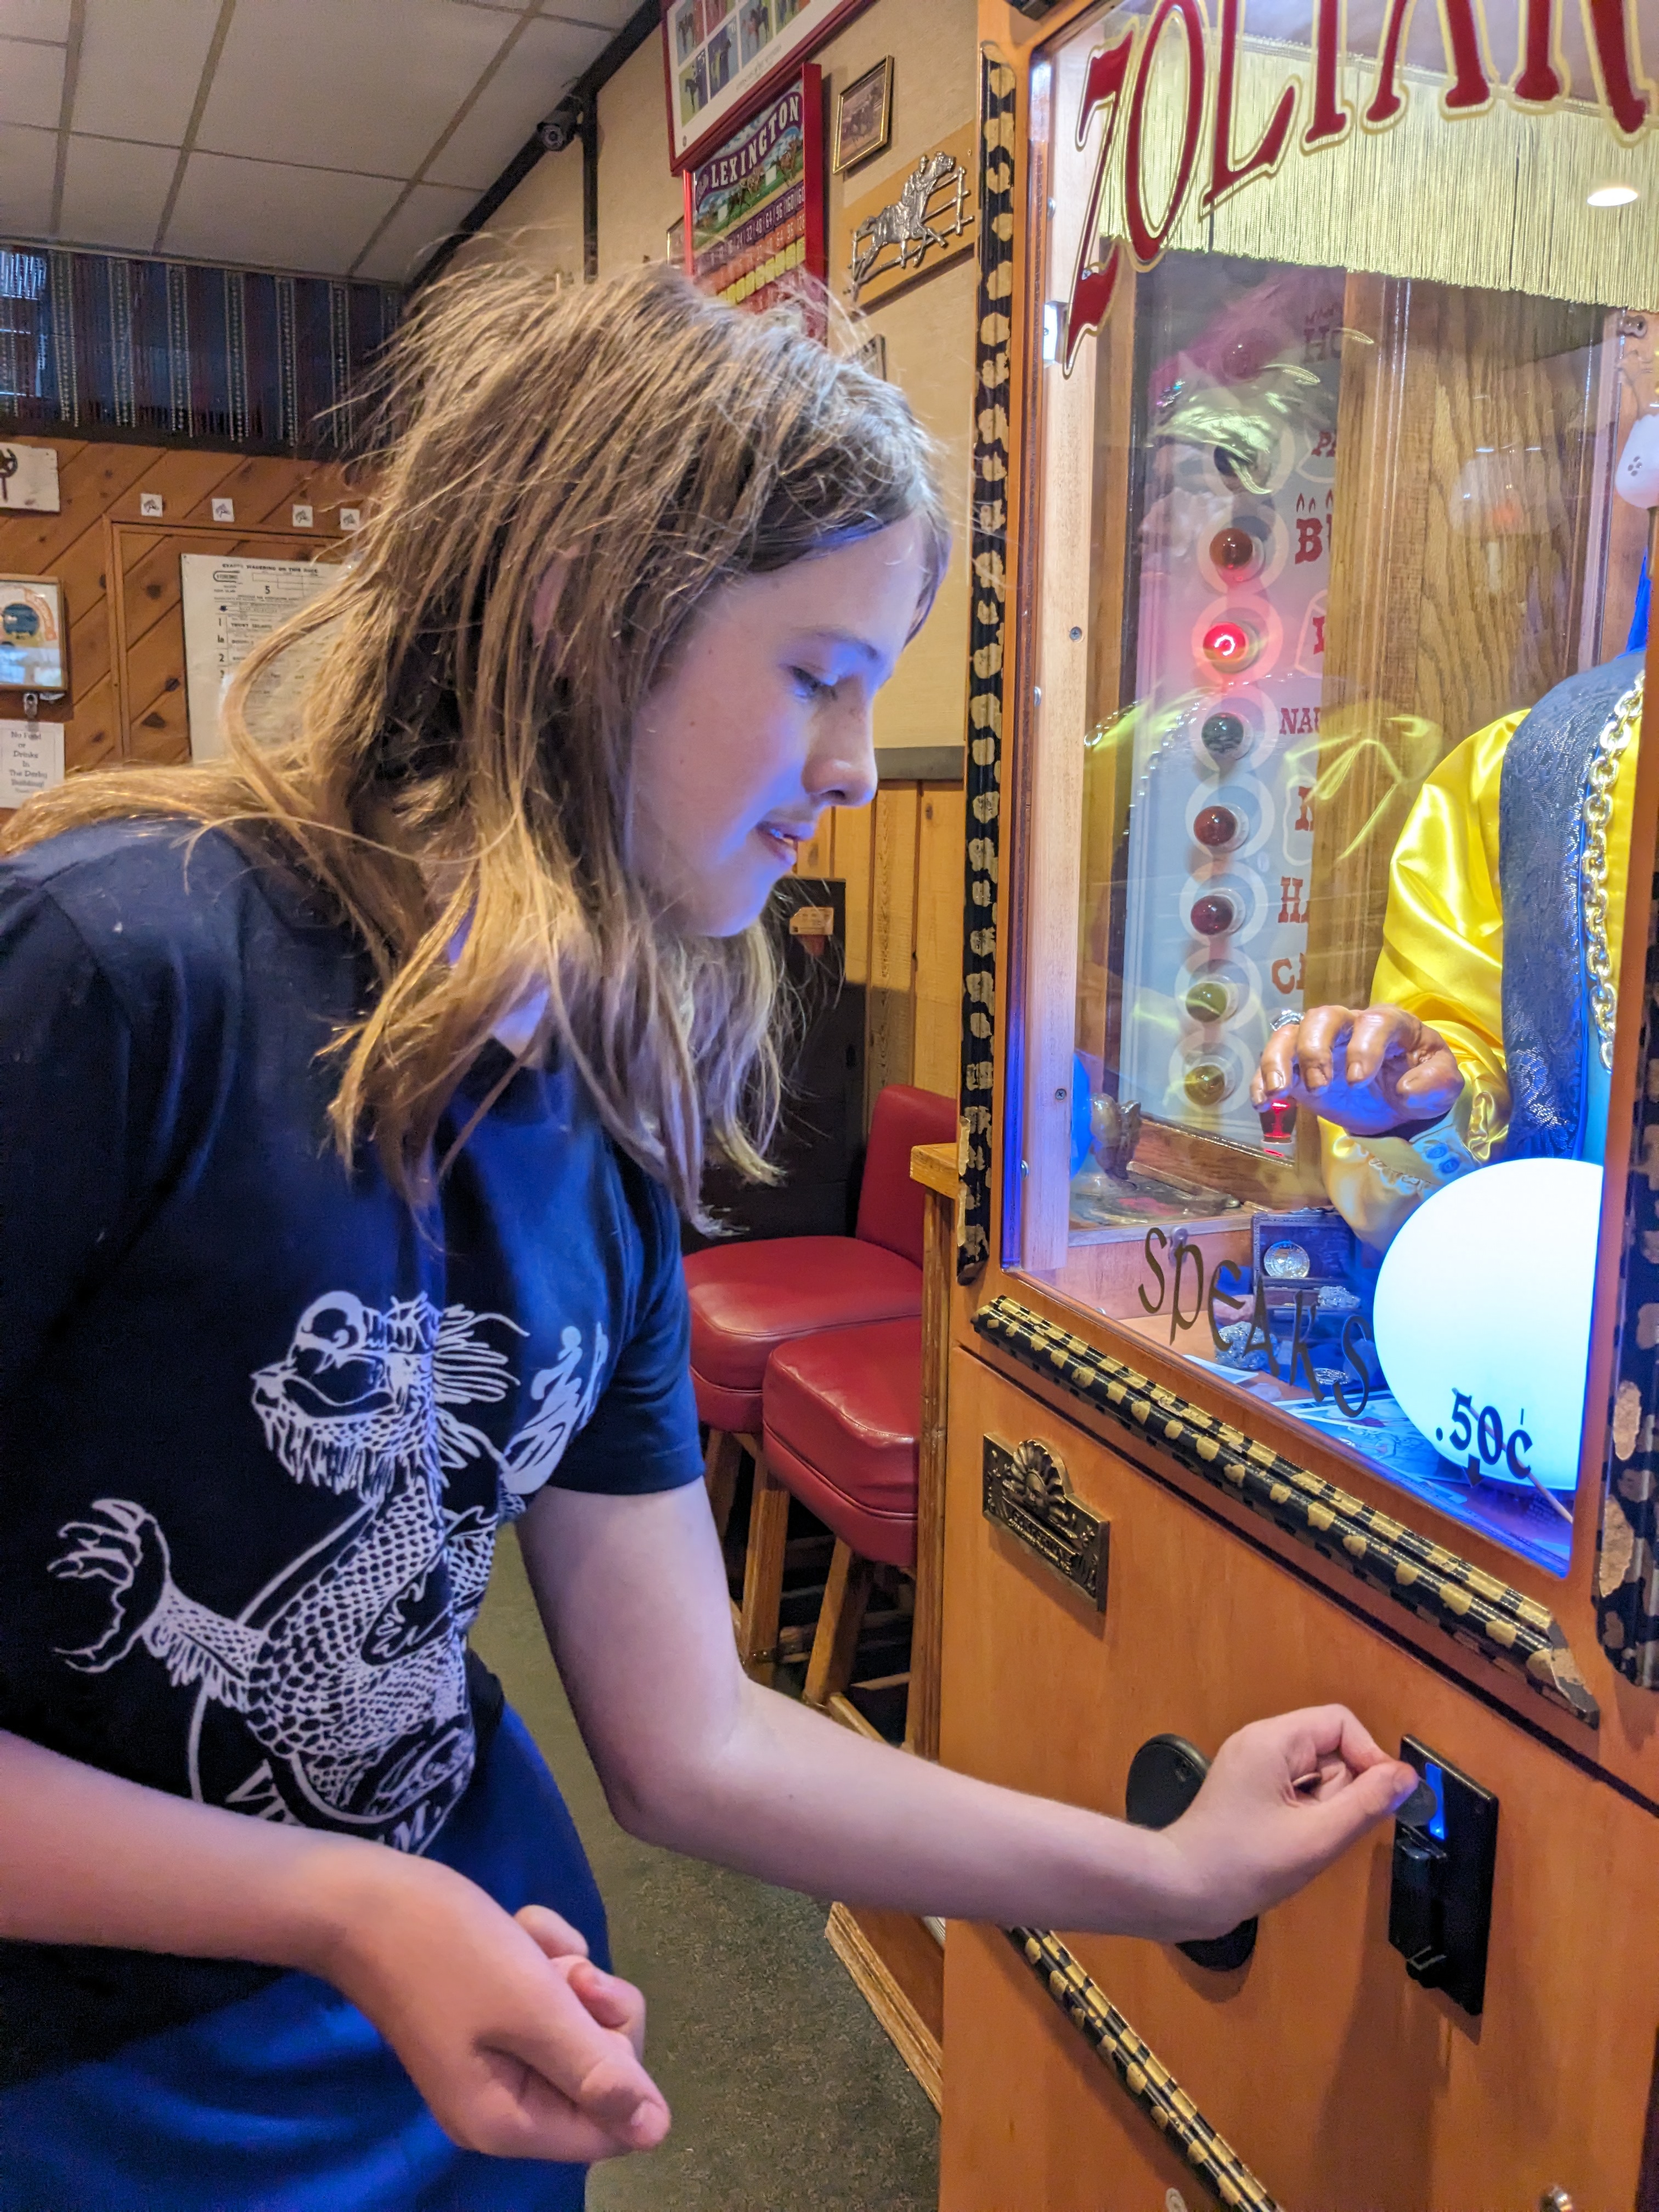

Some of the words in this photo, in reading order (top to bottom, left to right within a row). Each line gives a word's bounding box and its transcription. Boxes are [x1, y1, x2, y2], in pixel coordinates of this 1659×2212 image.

[711, 95, 799, 189] LEXINGTON
[746, 225, 753, 242] 32
[765, 210, 772, 228] 64
[776, 202, 783, 219] 96
[264, 585, 270, 595] 5
[219, 653, 224, 662] 2
[14, 750, 38, 759] Drinks
[25, 770, 48, 780] Derby
[1278, 876, 1310, 923] H
